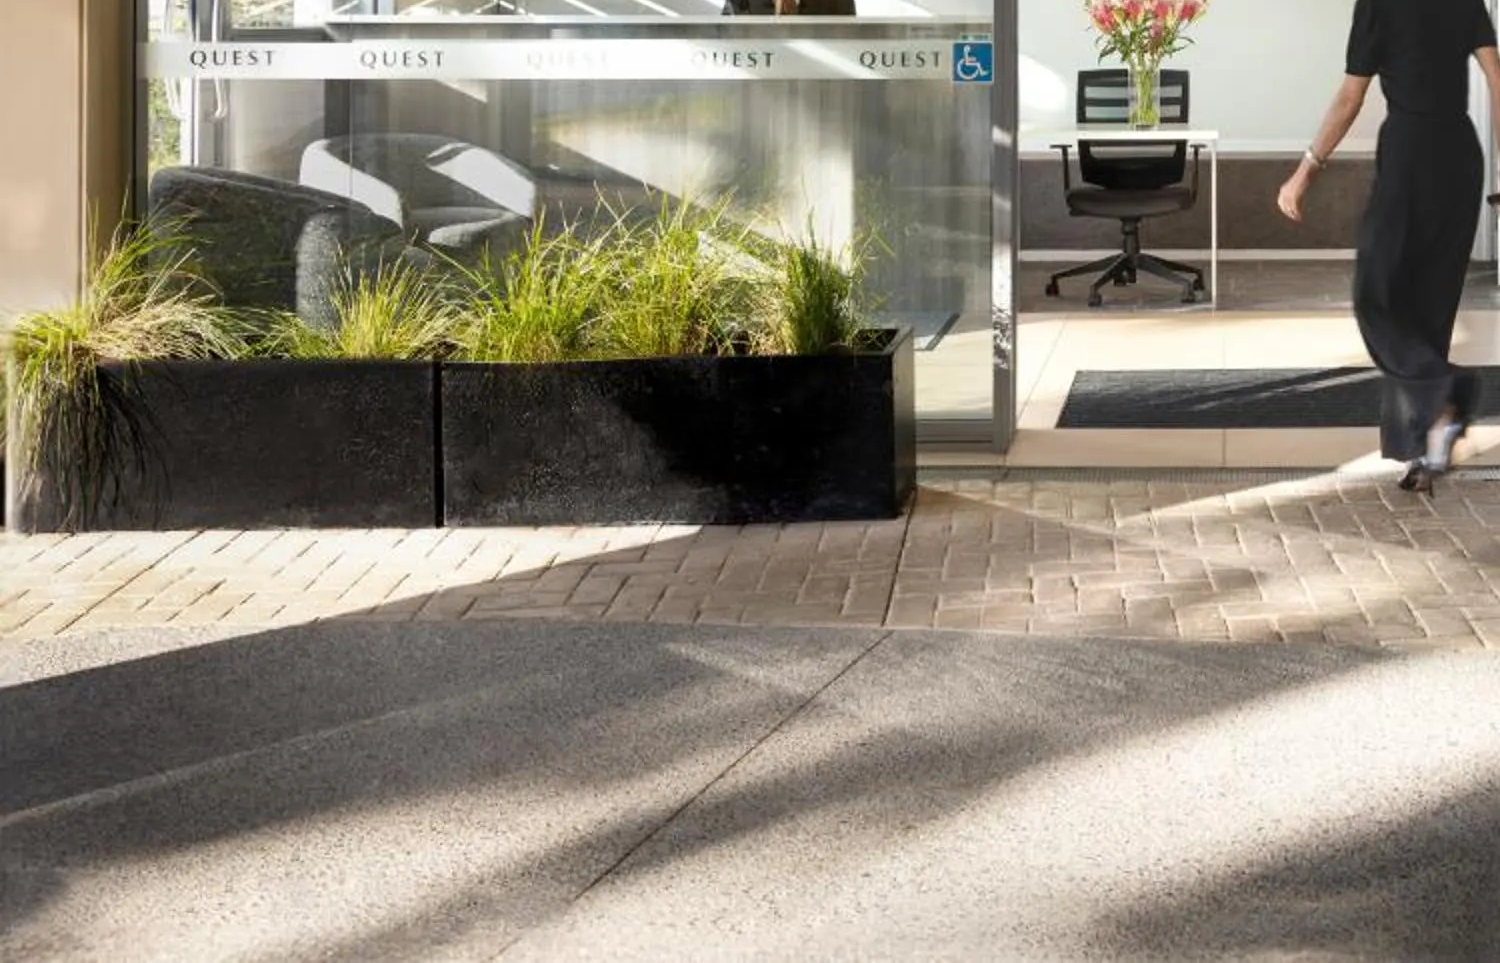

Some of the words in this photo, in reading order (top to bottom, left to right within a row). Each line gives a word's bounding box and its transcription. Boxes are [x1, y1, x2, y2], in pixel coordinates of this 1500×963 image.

[190, 50, 275, 67] QUEST
[360, 50, 446, 68] QUEST
[860, 50, 941, 69] QUEST
